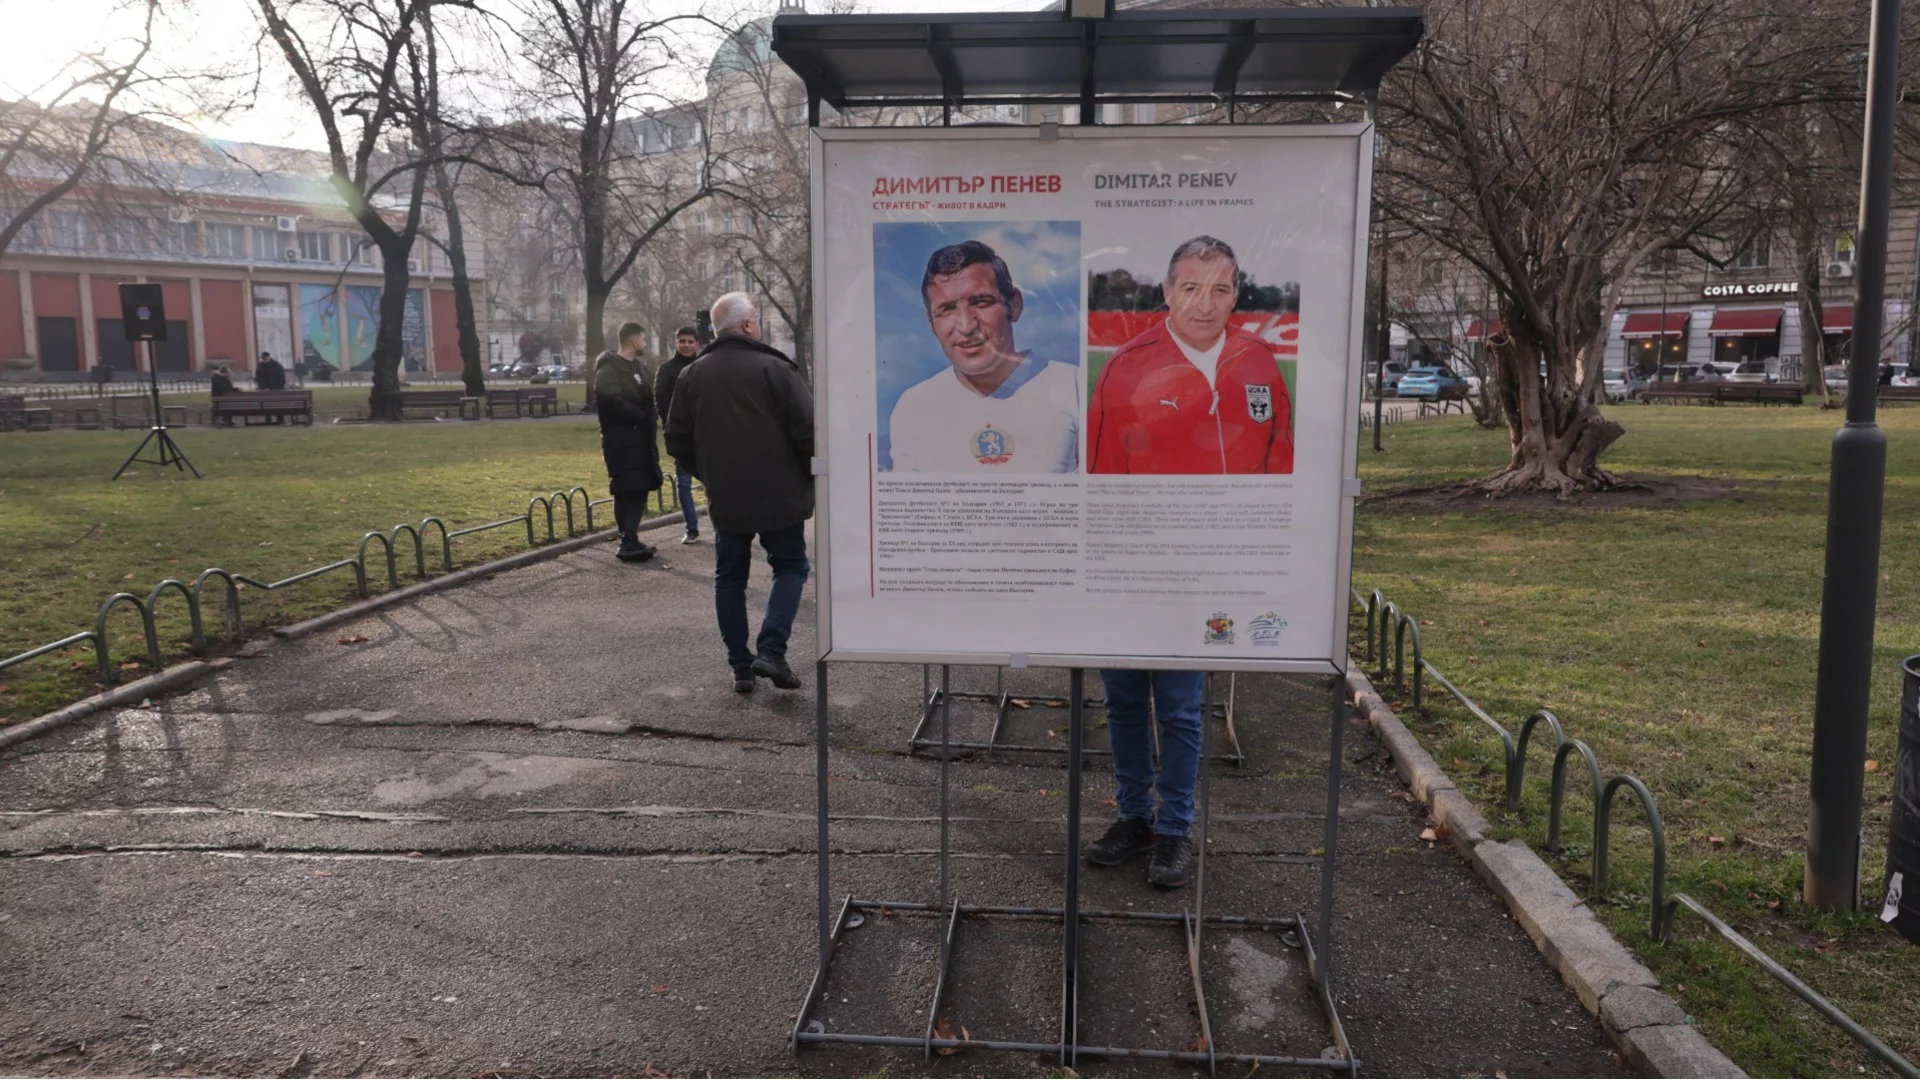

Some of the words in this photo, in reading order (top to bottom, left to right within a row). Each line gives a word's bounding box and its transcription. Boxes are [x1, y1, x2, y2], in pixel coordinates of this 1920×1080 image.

[872, 175, 985, 197] ДИМИТЪР
[991, 175, 1061, 193] ПЕНЕВ
[1095, 173, 1172, 189] DIMITAR
[1178, 172, 1237, 188] PENEV
[872, 201, 930, 210] СТРАТЕГЪТ
[937, 201, 967, 209] ЖИВОТ
[976, 201, 1006, 210] КАДРИ
[1094, 200, 1113, 208] THE
[1185, 199, 1204, 207] LIFE
[1219, 198, 1254, 206] FRAMES
[1703, 285, 1745, 297] COSTA
[1747, 282, 1799, 295] COFFEE
